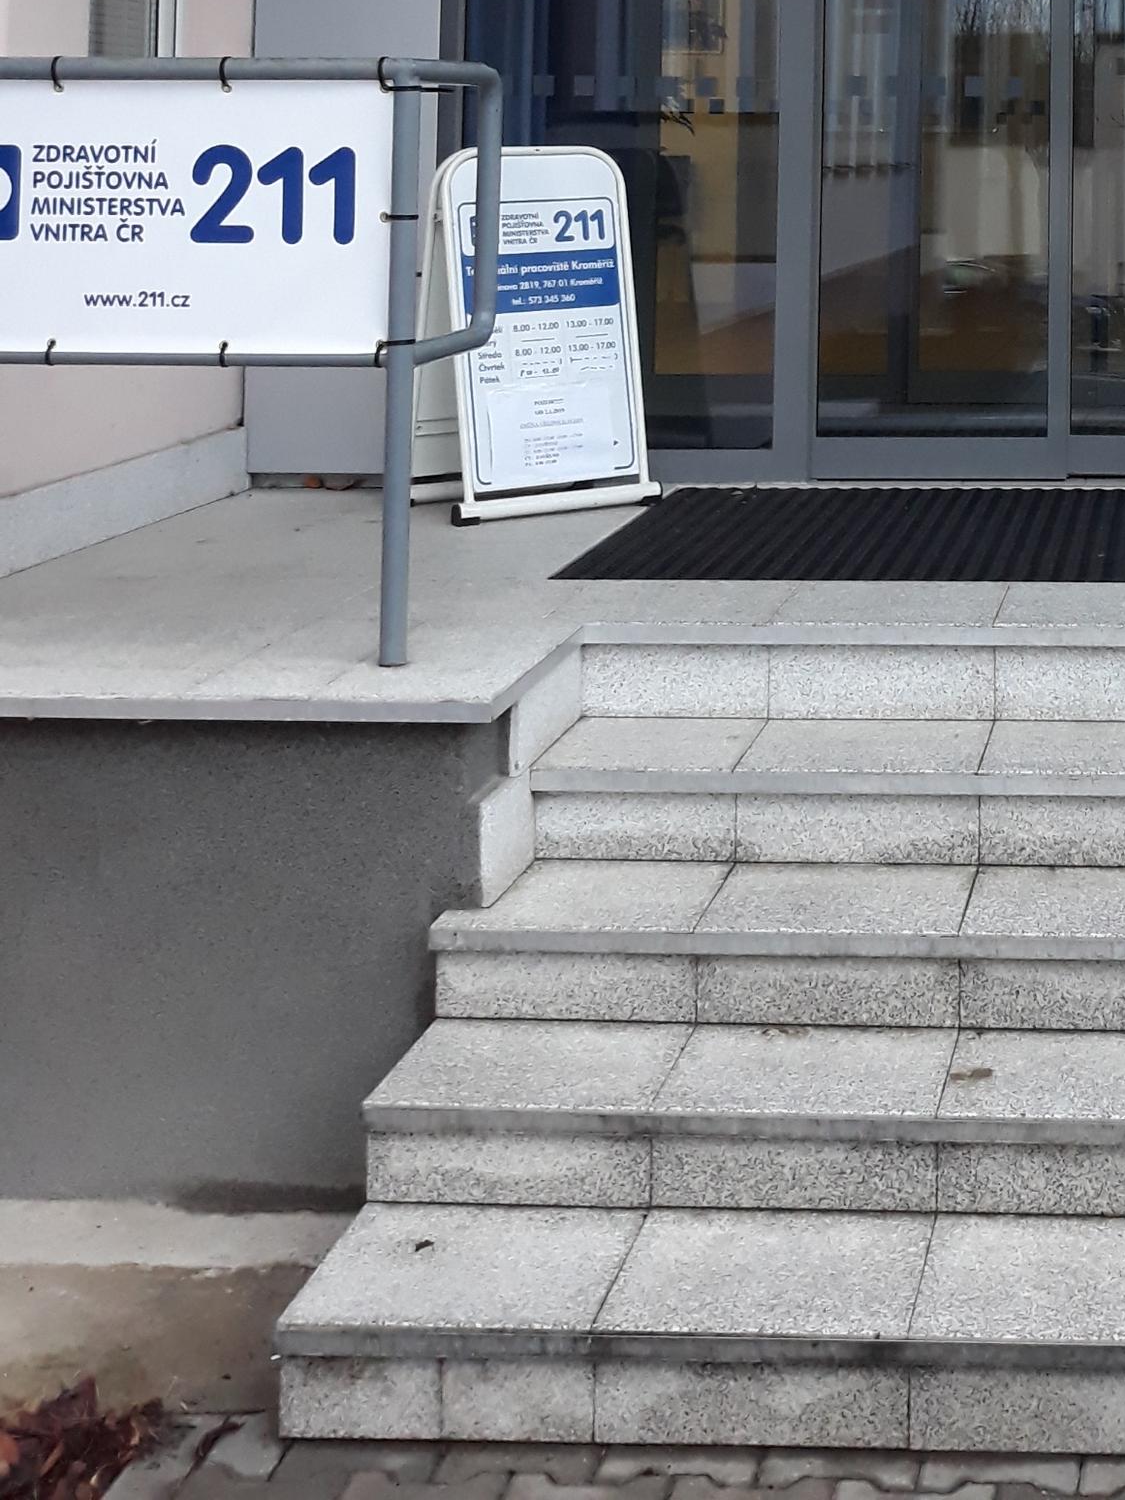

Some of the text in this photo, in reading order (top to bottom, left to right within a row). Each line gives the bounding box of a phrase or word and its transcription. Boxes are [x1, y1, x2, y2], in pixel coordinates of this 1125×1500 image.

[32, 138, 159, 163] ZDRAVOTNÍ
[33, 166, 169, 190] POJIŠŤOVNA
[190, 144, 356, 245] 211
[30, 197, 185, 216] MINISTERSTVA
[30, 218, 144, 242] VNITRA ČR
[553, 209, 605, 242] 211
[521, 261, 569, 276] pracoviště
[571, 259, 615, 271] Kroměříž
[558, 279, 568, 287] 01
[84, 291, 191, 308] www.211.cz
[513, 324, 530, 333] 8.00
[538, 321, 560, 330] 12.00
[566, 319, 587, 328] 13.00
[515, 348, 532, 356] 8.00
[540, 345, 561, 354] 12.00
[568, 343, 589, 352] 13.00
